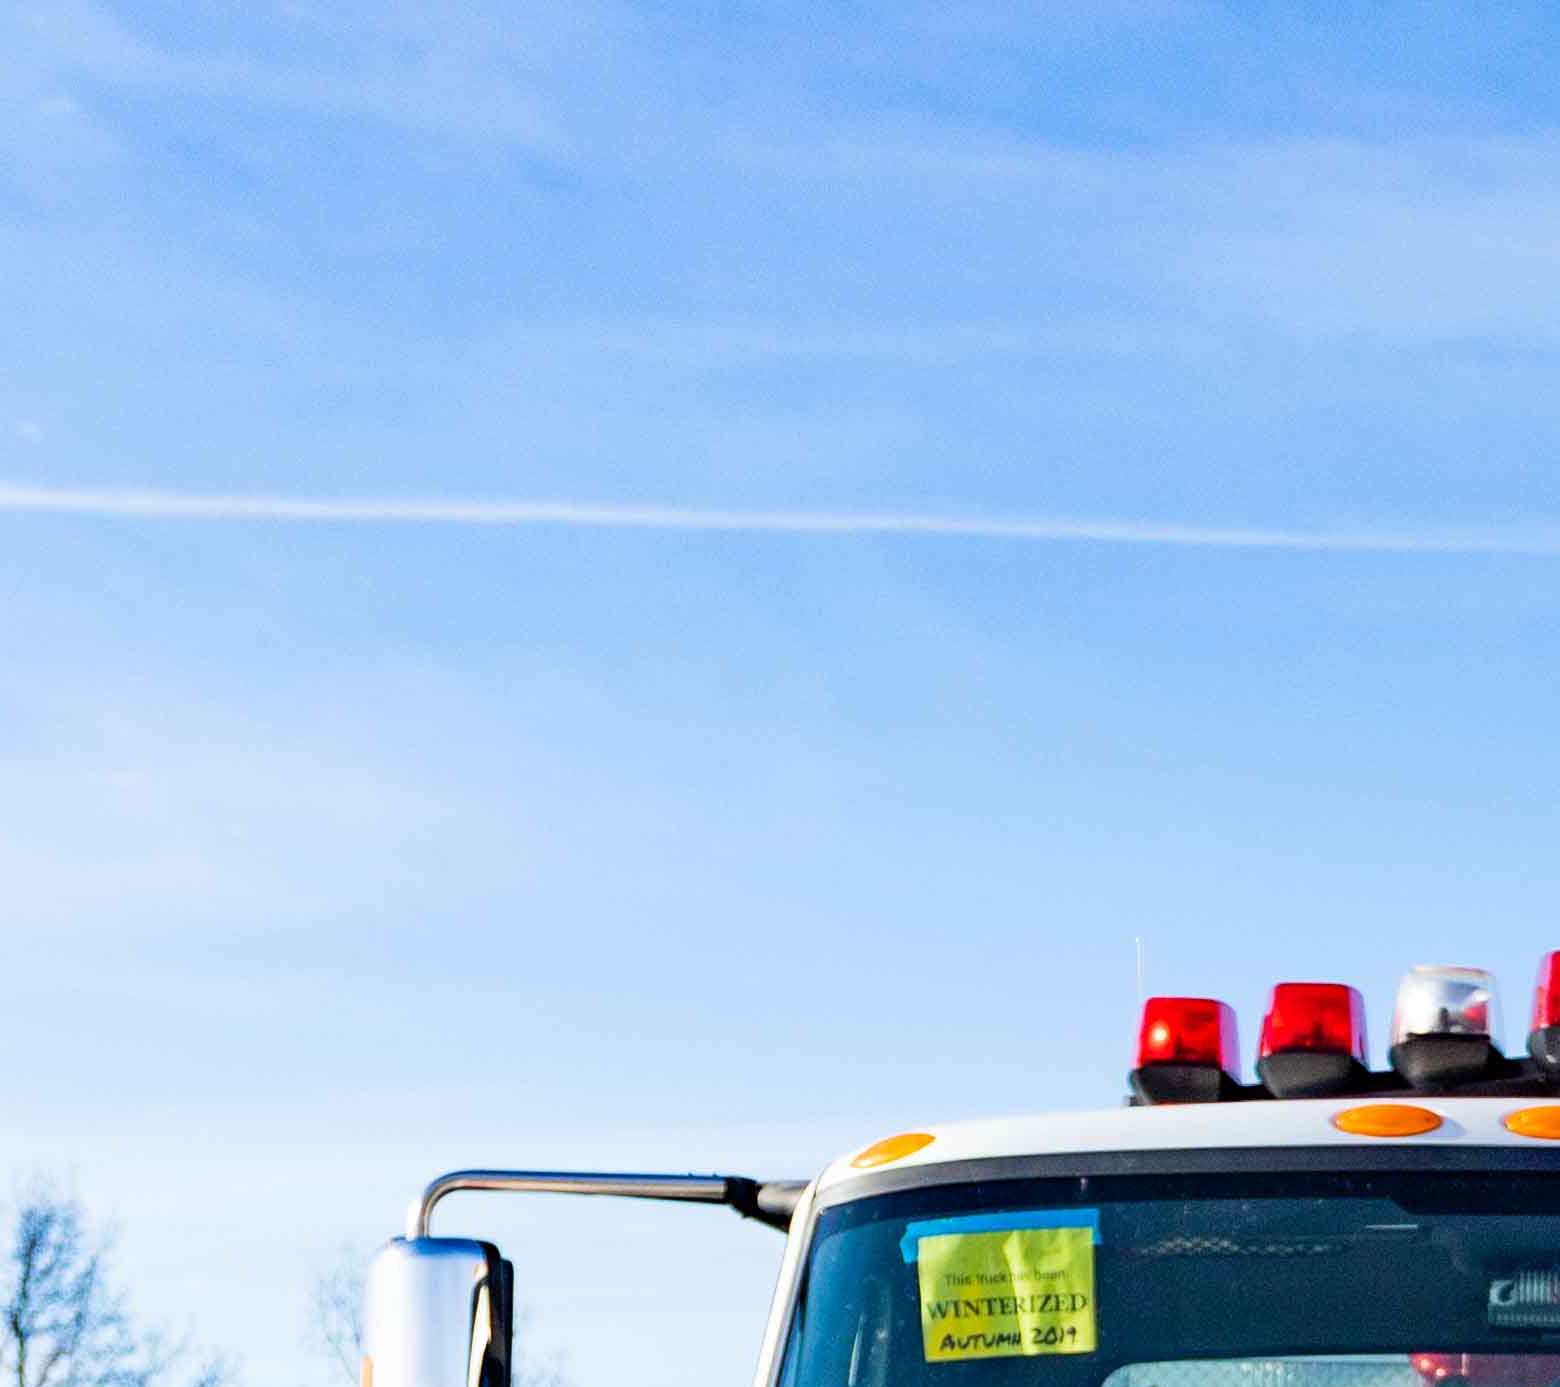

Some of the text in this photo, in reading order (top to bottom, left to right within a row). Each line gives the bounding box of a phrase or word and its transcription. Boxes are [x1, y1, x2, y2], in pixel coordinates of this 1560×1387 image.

[926, 1293, 1088, 1320] WINTERIZED
[939, 1325, 1077, 1350] AUTUMN 2019
